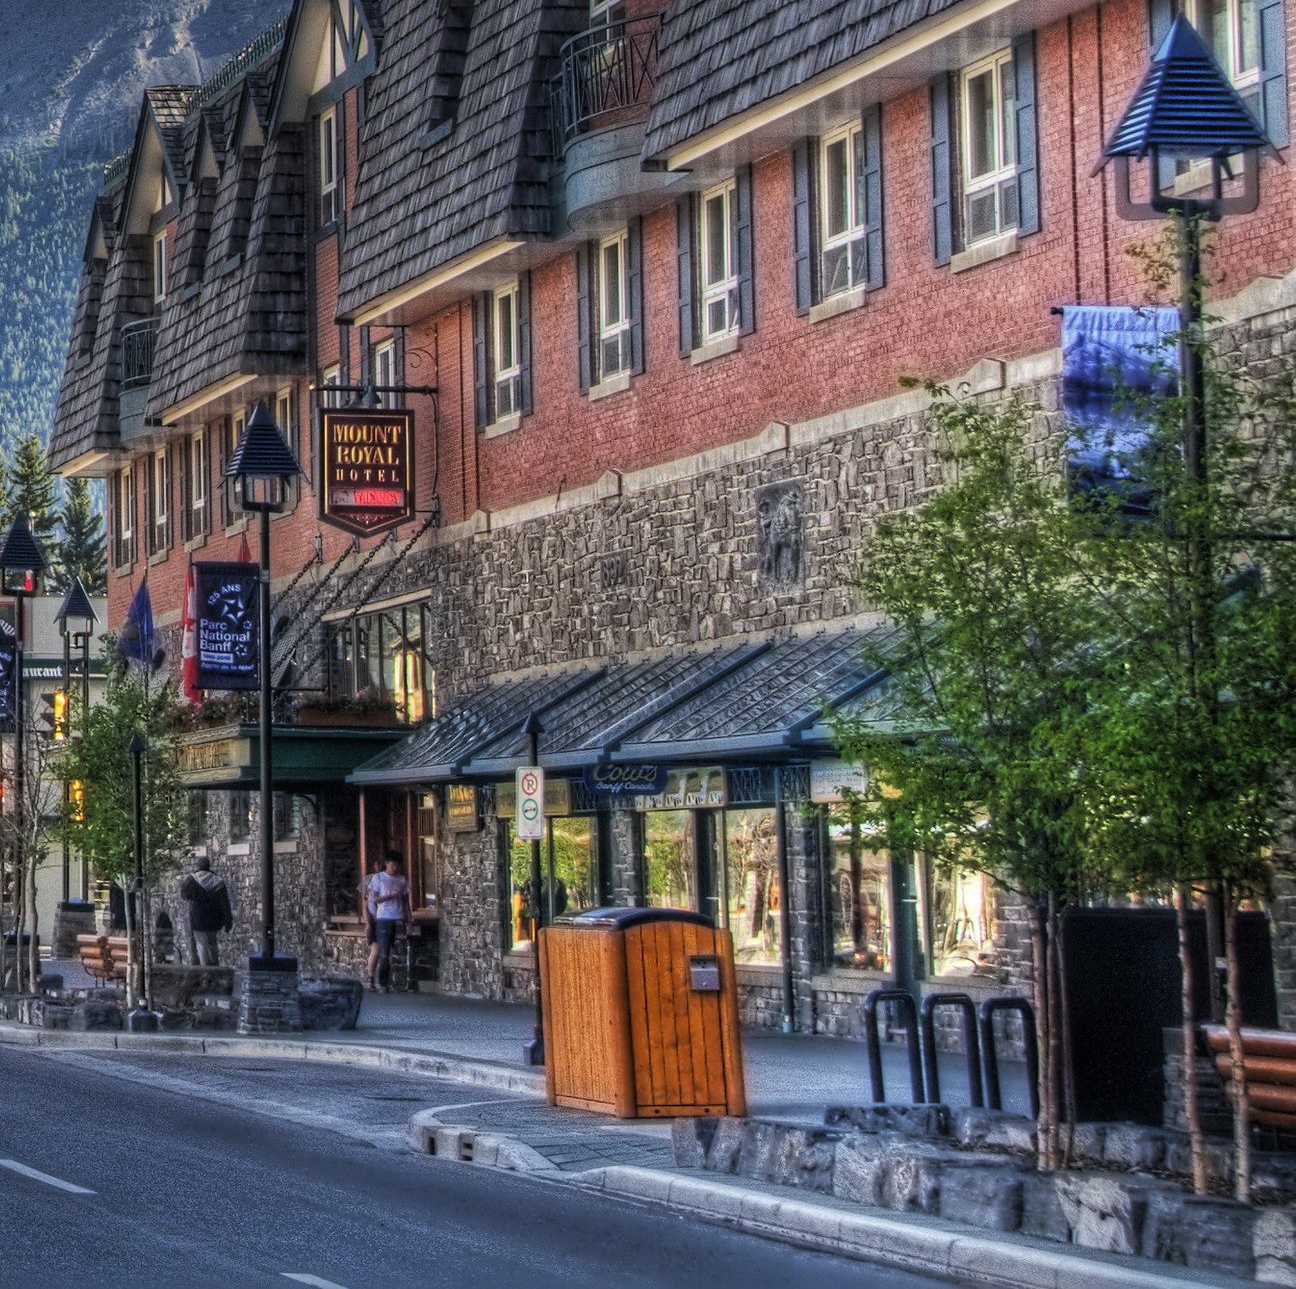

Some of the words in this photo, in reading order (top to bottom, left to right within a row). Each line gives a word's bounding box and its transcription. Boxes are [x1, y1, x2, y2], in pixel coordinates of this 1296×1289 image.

[333, 424, 401, 444] MOUNT
[336, 445, 400, 465] ROYAL
[336, 468, 400, 482] HOTEL
[354, 490, 402, 505] VACANCY
[208, 591, 221, 606] 125
[221, 584, 241, 594] ANS
[200, 618, 227, 630] Parc
[200, 629, 250, 642] National
[200, 639, 232, 651] Banff
